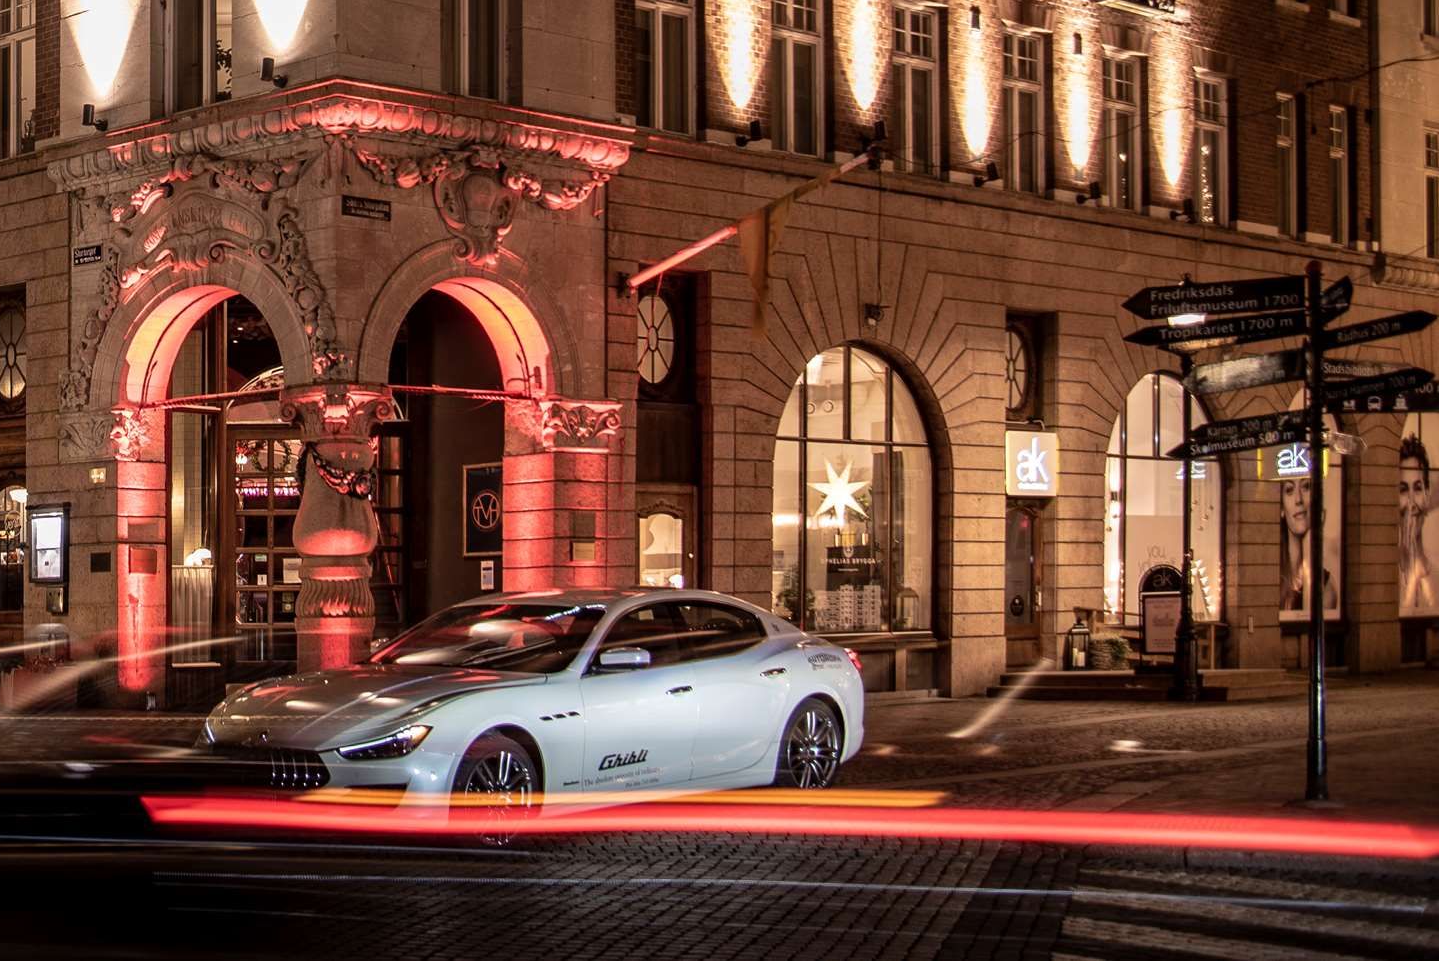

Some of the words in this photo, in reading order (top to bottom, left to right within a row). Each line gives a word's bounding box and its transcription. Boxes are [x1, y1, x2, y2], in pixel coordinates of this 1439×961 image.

[1150, 284, 1234, 301] Fredriksdals
[1150, 298, 1258, 316] Friluftsmuseum
[1263, 294, 1299, 307] 1700
[1160, 322, 1236, 340] Tropikariet
[1239, 317, 1275, 331] 1700
[1279, 317, 1294, 327] m
[1015, 436, 1049, 483] ak
[1277, 443, 1310, 469] ak
[597, 748, 649, 771] Ghibli
